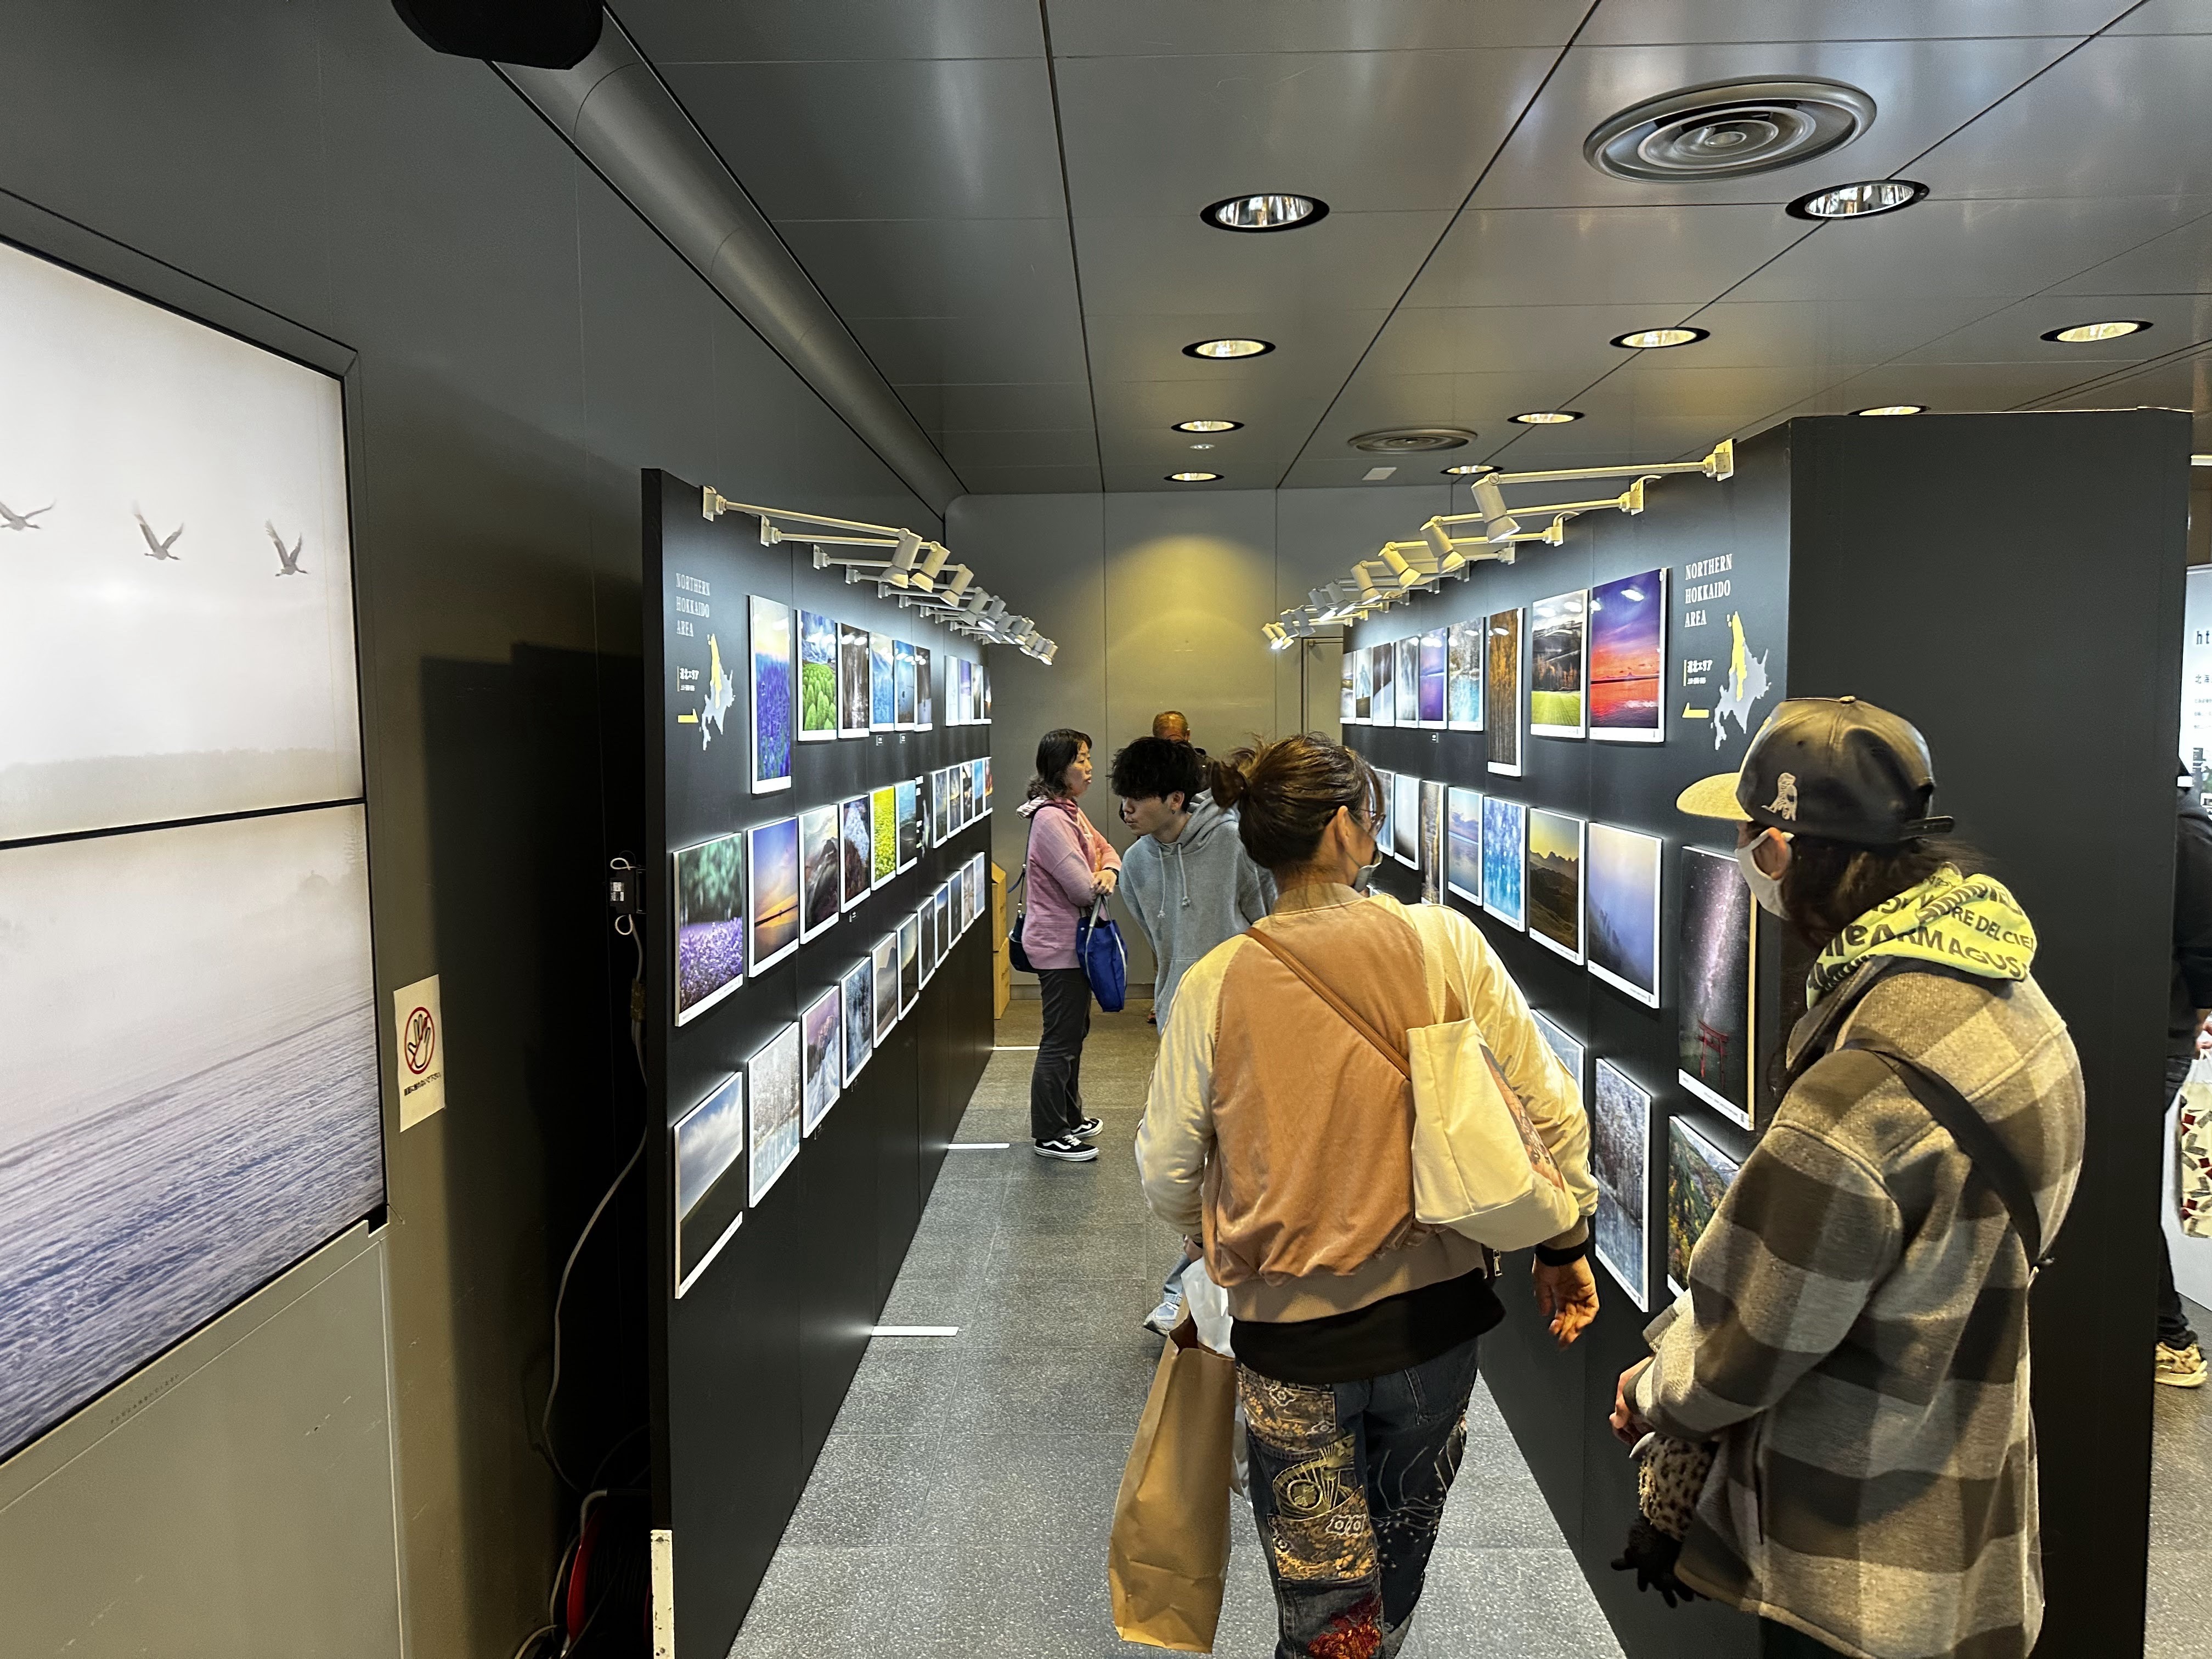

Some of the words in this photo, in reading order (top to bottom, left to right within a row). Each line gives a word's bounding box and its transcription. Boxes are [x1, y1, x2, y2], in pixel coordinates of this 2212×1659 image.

[1685, 554, 1733, 580] NORTHERN
[676, 573, 710, 596] NORTHERN
[1685, 579, 1731, 604] HOKKAIDO
[676, 596, 710, 618] HOKKAIDO
[676, 620, 694, 637] AREA
[1684, 610, 1707, 628] AREA
